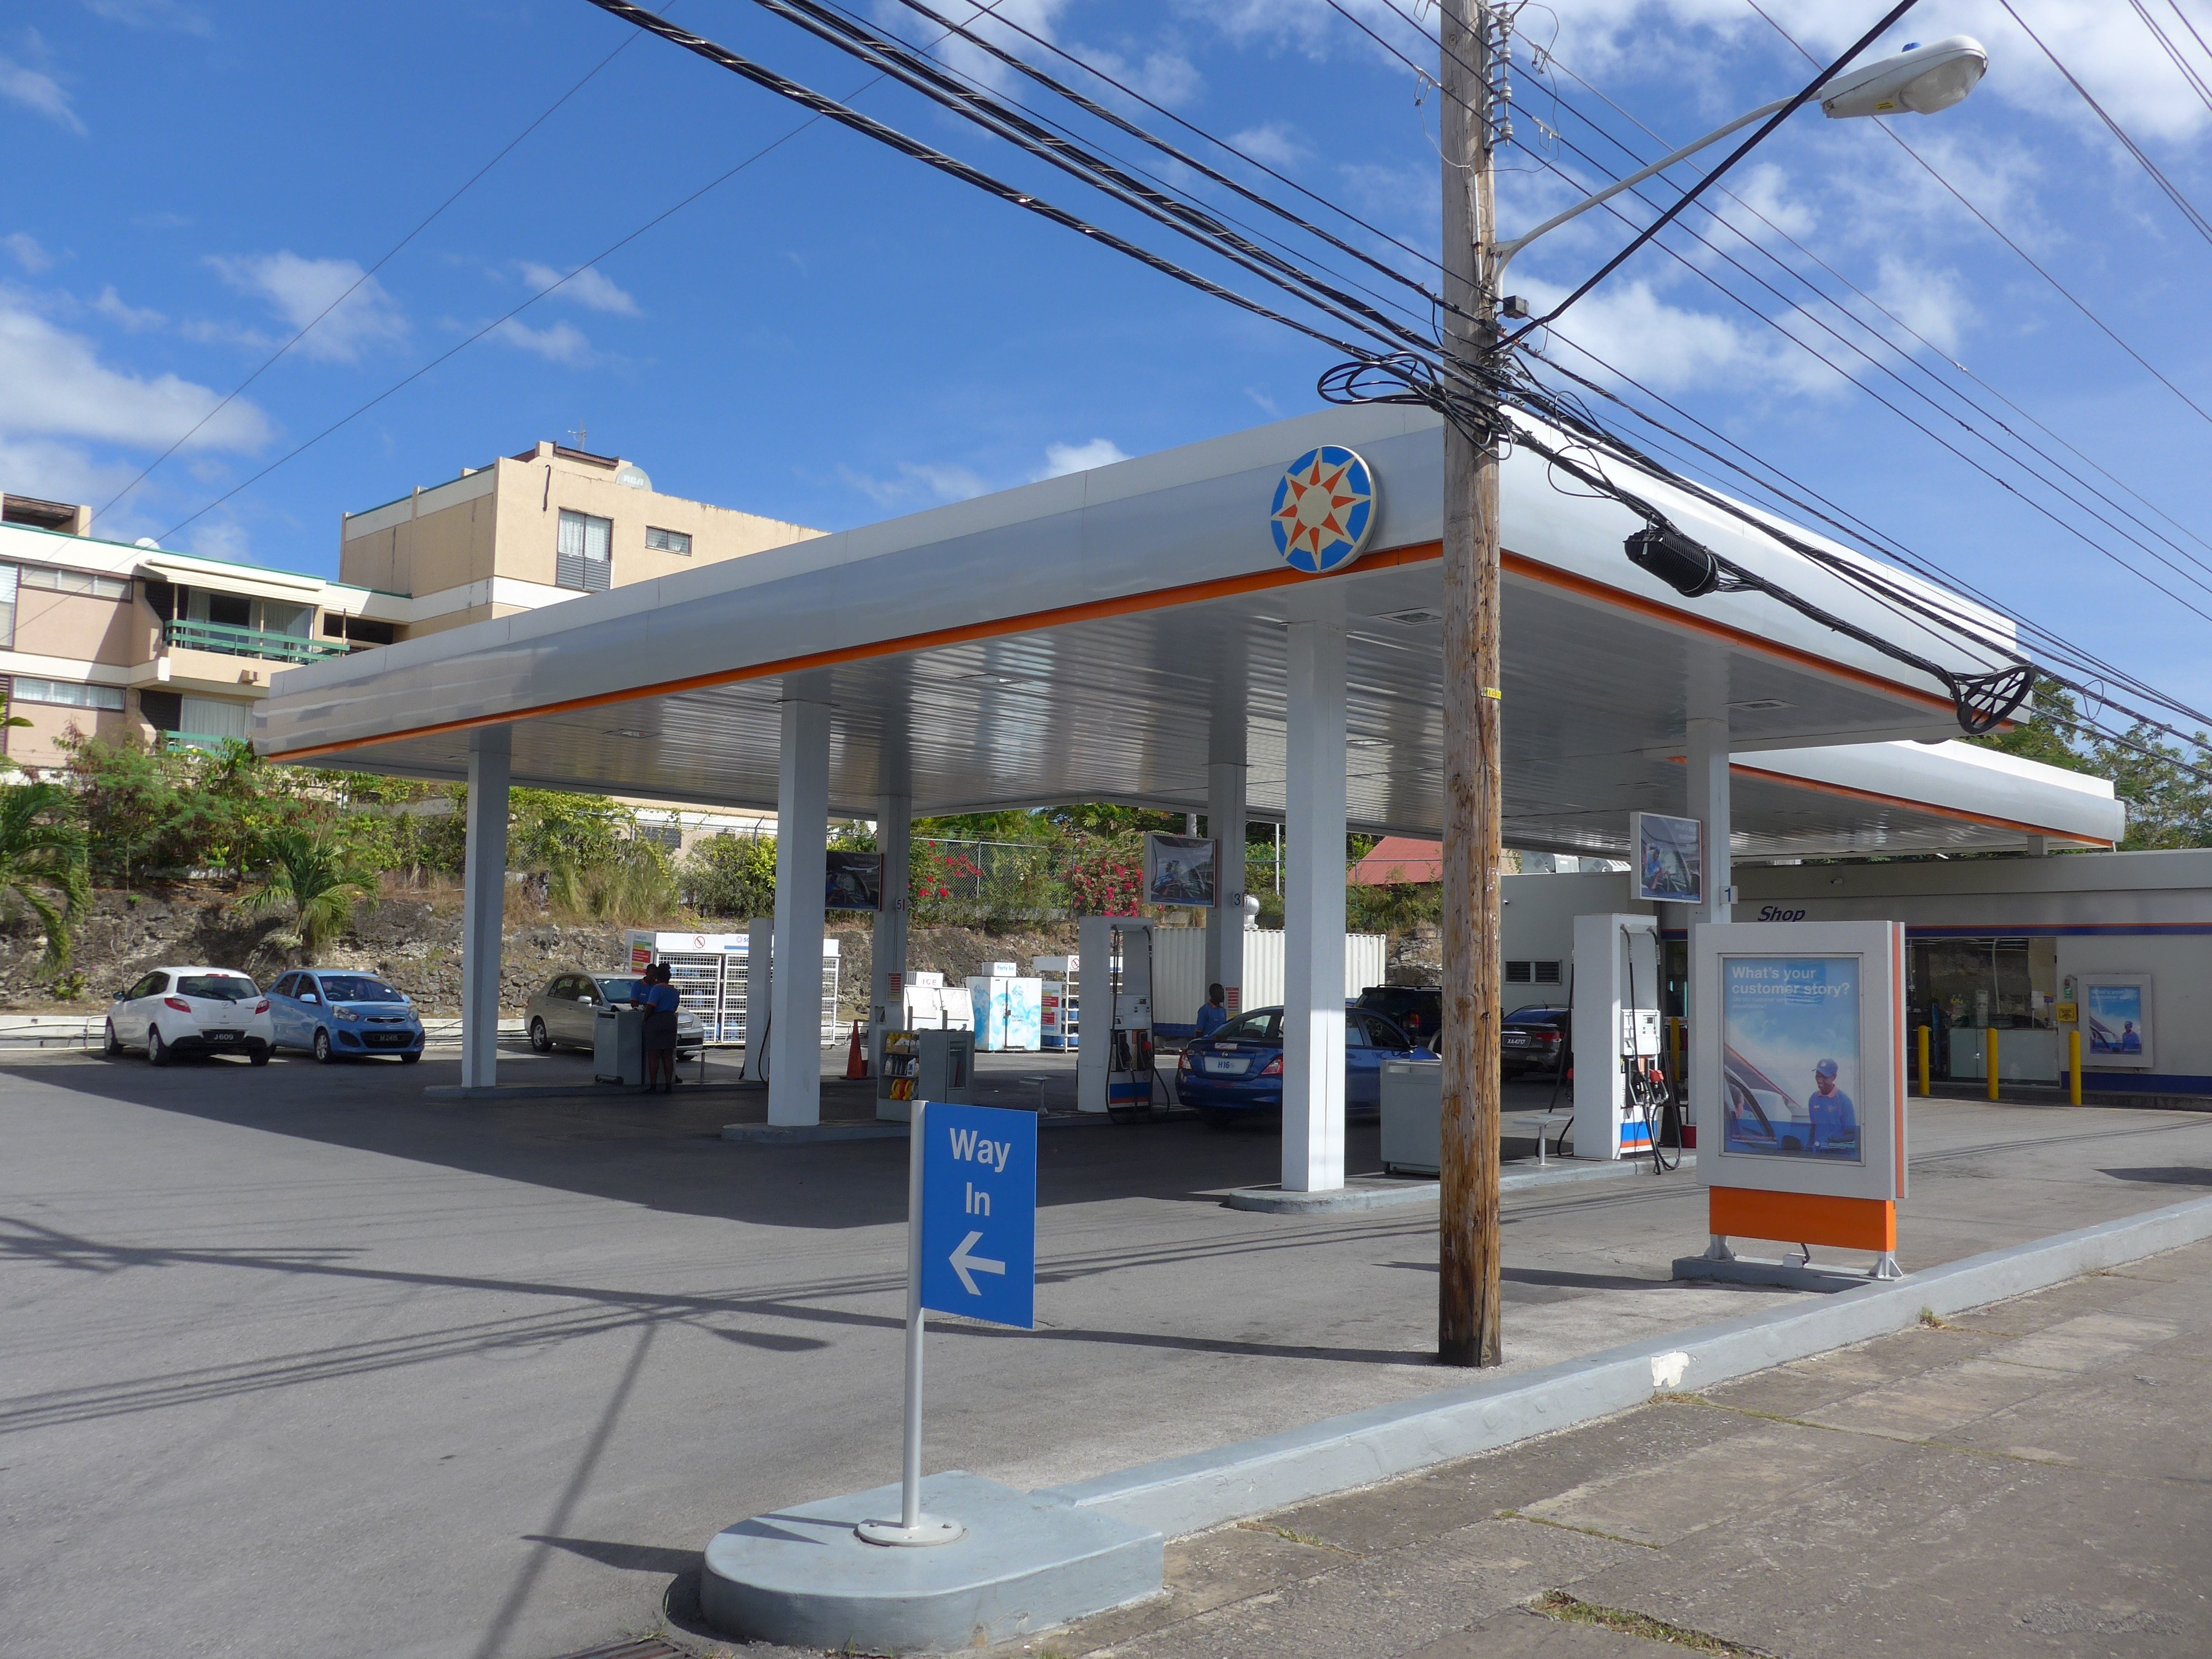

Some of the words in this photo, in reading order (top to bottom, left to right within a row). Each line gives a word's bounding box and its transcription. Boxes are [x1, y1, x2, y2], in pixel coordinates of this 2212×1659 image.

[623, 474, 644, 486] RCA
[1234, 893, 1240, 906] 3
[1724, 888, 1731, 902] 1
[897, 899, 902, 910] 5
[1757, 905, 1806, 922] Shop
[1731, 967, 1780, 979] What's
[1783, 968, 1816, 981] your
[1731, 983, 1802, 994] customer
[1803, 982, 1851, 998] story?
[950, 1127, 1011, 1173] Way
[966, 1182, 990, 1217] In
